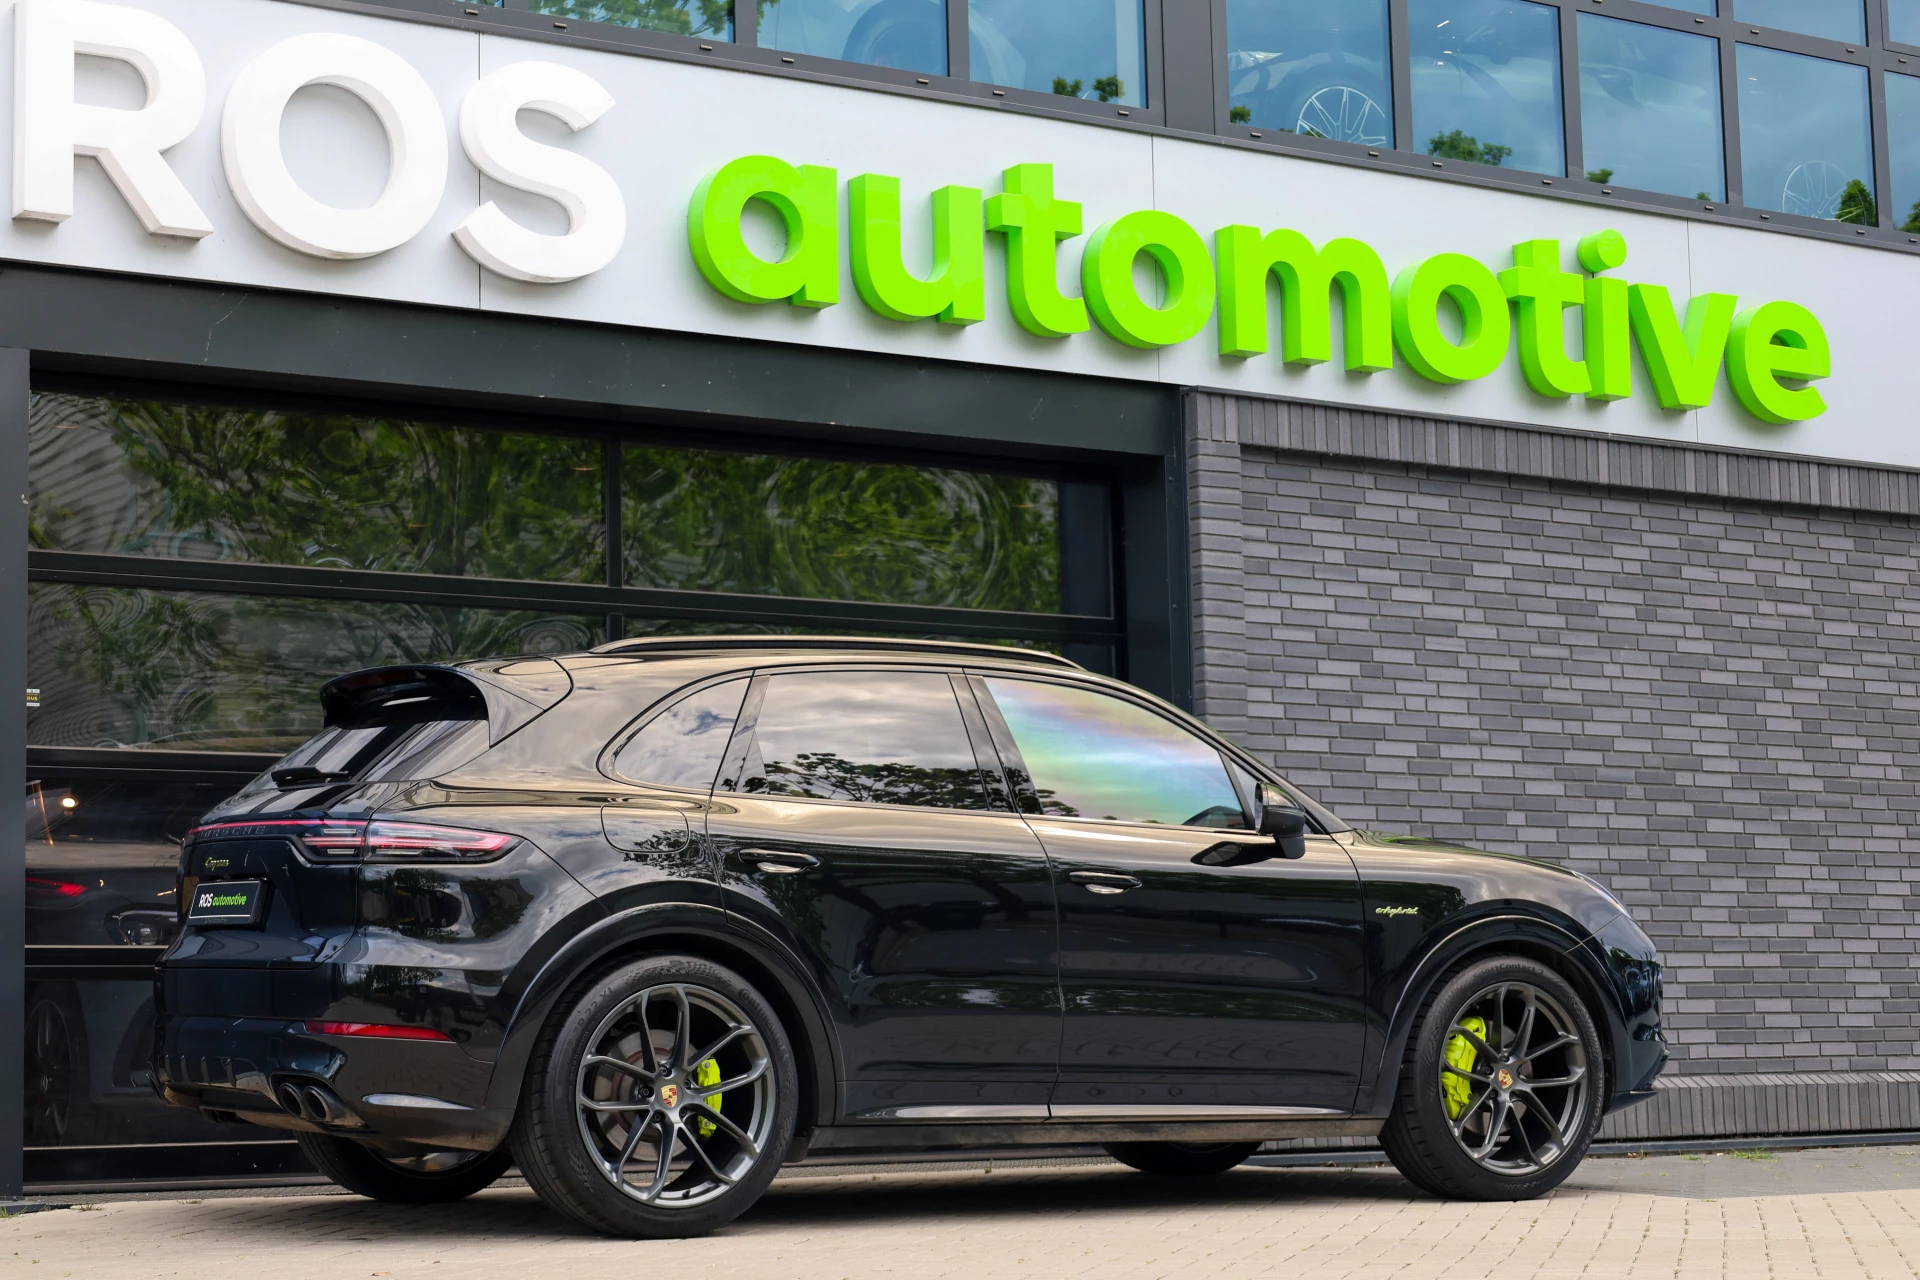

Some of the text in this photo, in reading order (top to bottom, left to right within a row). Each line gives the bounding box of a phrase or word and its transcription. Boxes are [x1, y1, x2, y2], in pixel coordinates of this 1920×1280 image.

[12, 0, 1831, 424] ROS automotive
[198, 892, 247, 908] ROS automotive
